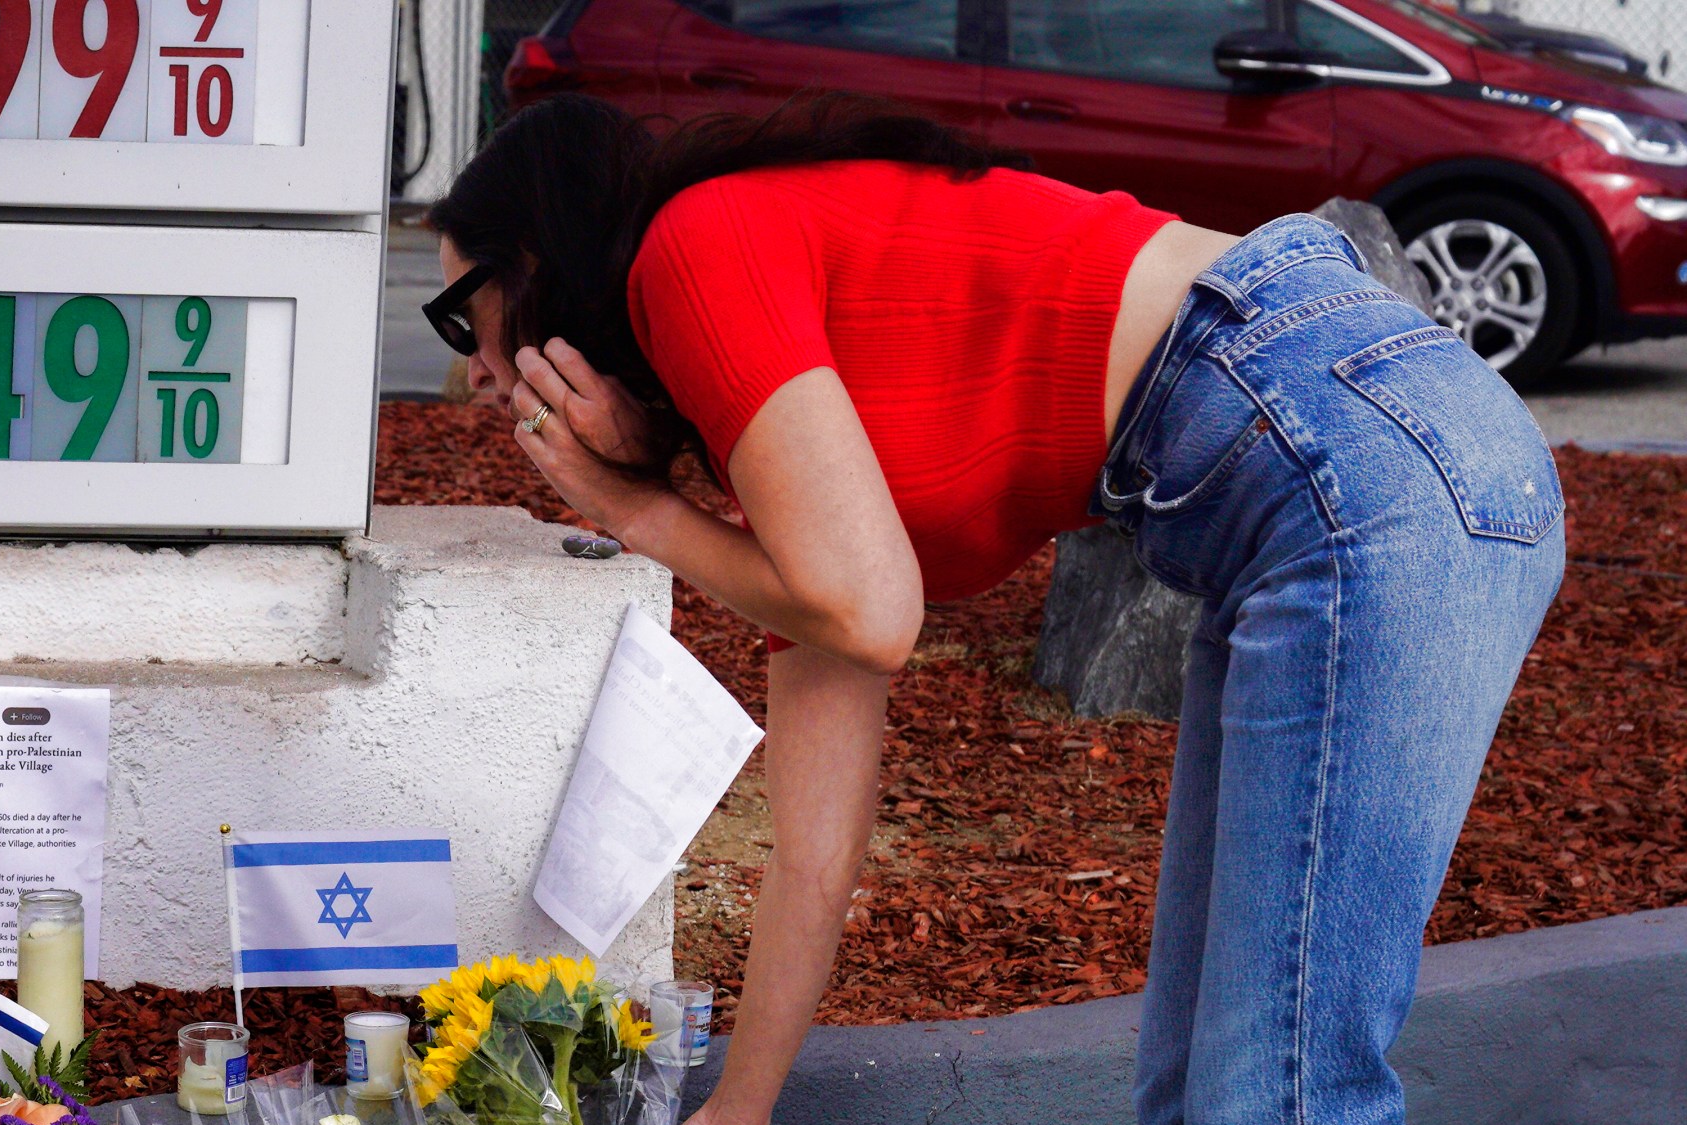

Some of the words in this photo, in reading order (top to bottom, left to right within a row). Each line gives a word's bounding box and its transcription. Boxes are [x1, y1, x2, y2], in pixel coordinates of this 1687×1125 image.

[169, 65, 233, 137] 10
[173, 297, 212, 369] 9
[154, 387, 221, 460] 10
[21, 713, 43, 721] Follow
[6, 731, 25, 742] dies
[28, 731, 52, 742] after
[6, 746, 81, 759] pro-Palestinian
[18, 760, 52, 774] Village
[12, 813, 28, 821] died
[36, 813, 50, 822] day
[52, 813, 70, 821] after
[72, 813, 81, 821] he
[52, 827, 68, 835] pro-
[8, 839, 35, 849] Village,
[37, 839, 76, 847] authorities
